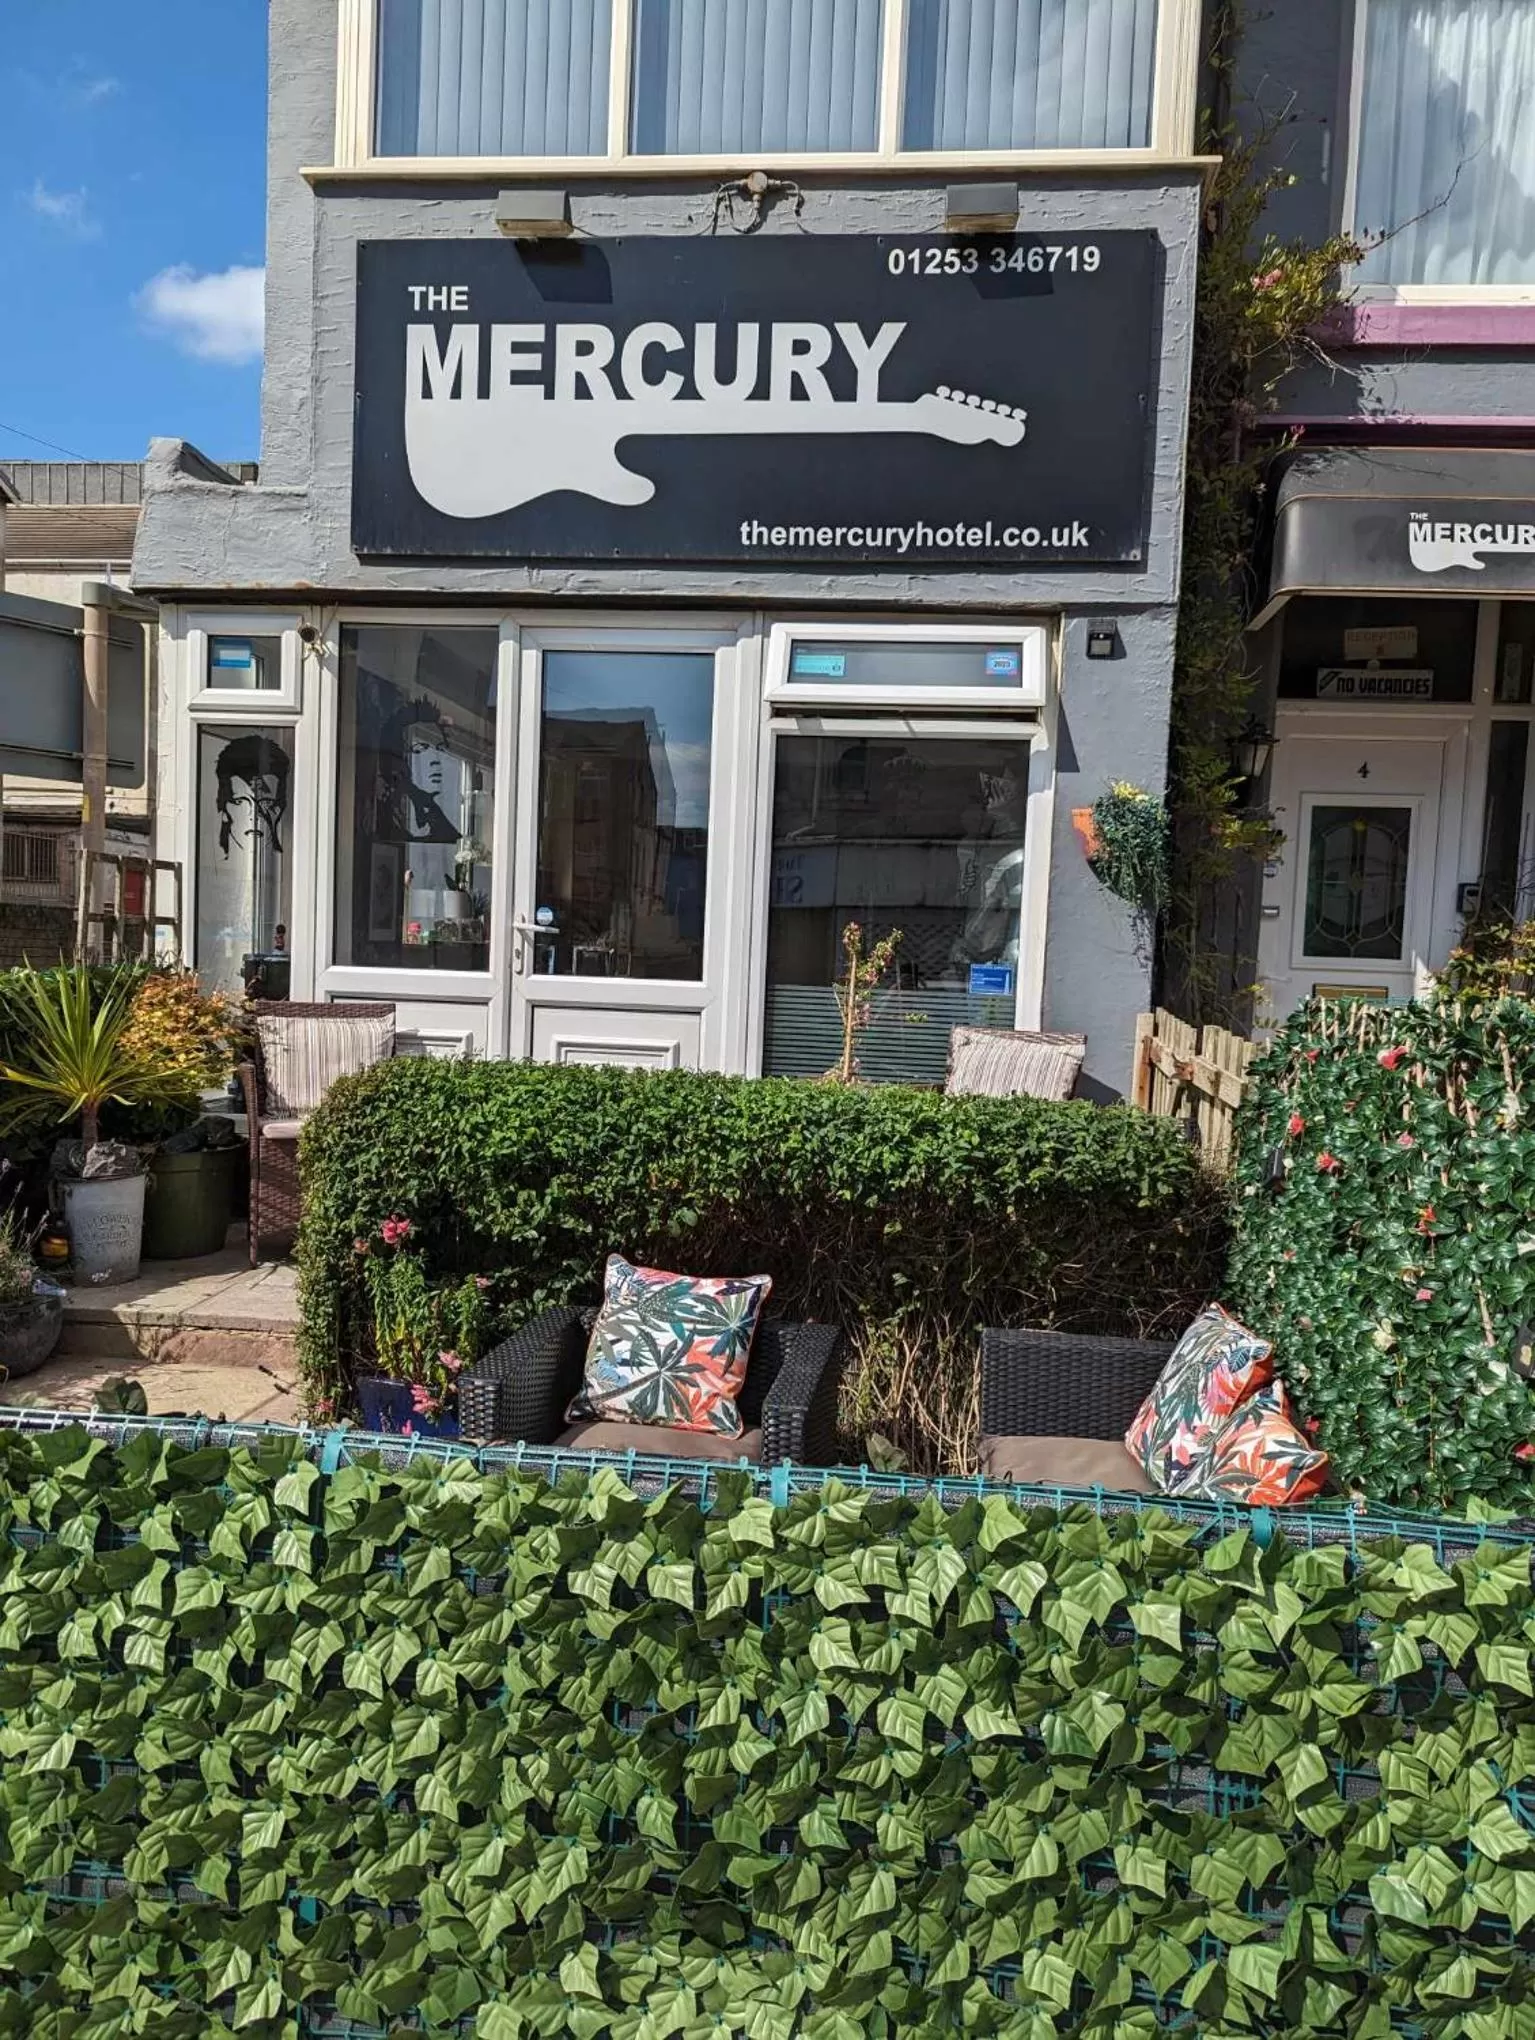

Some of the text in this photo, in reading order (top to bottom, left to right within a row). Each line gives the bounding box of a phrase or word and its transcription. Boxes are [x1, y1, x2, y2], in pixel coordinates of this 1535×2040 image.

[888, 246, 1101, 275] 01253 346719
[408, 285, 469, 311] THE
[405, 321, 908, 402] MERCURY
[1409, 512, 1429, 521] THE
[740, 520, 1089, 553] themercuryhotel.co.uk
[1336, 677, 1431, 695] NO VACANCIES
[1357, 761, 1371, 779] 4
